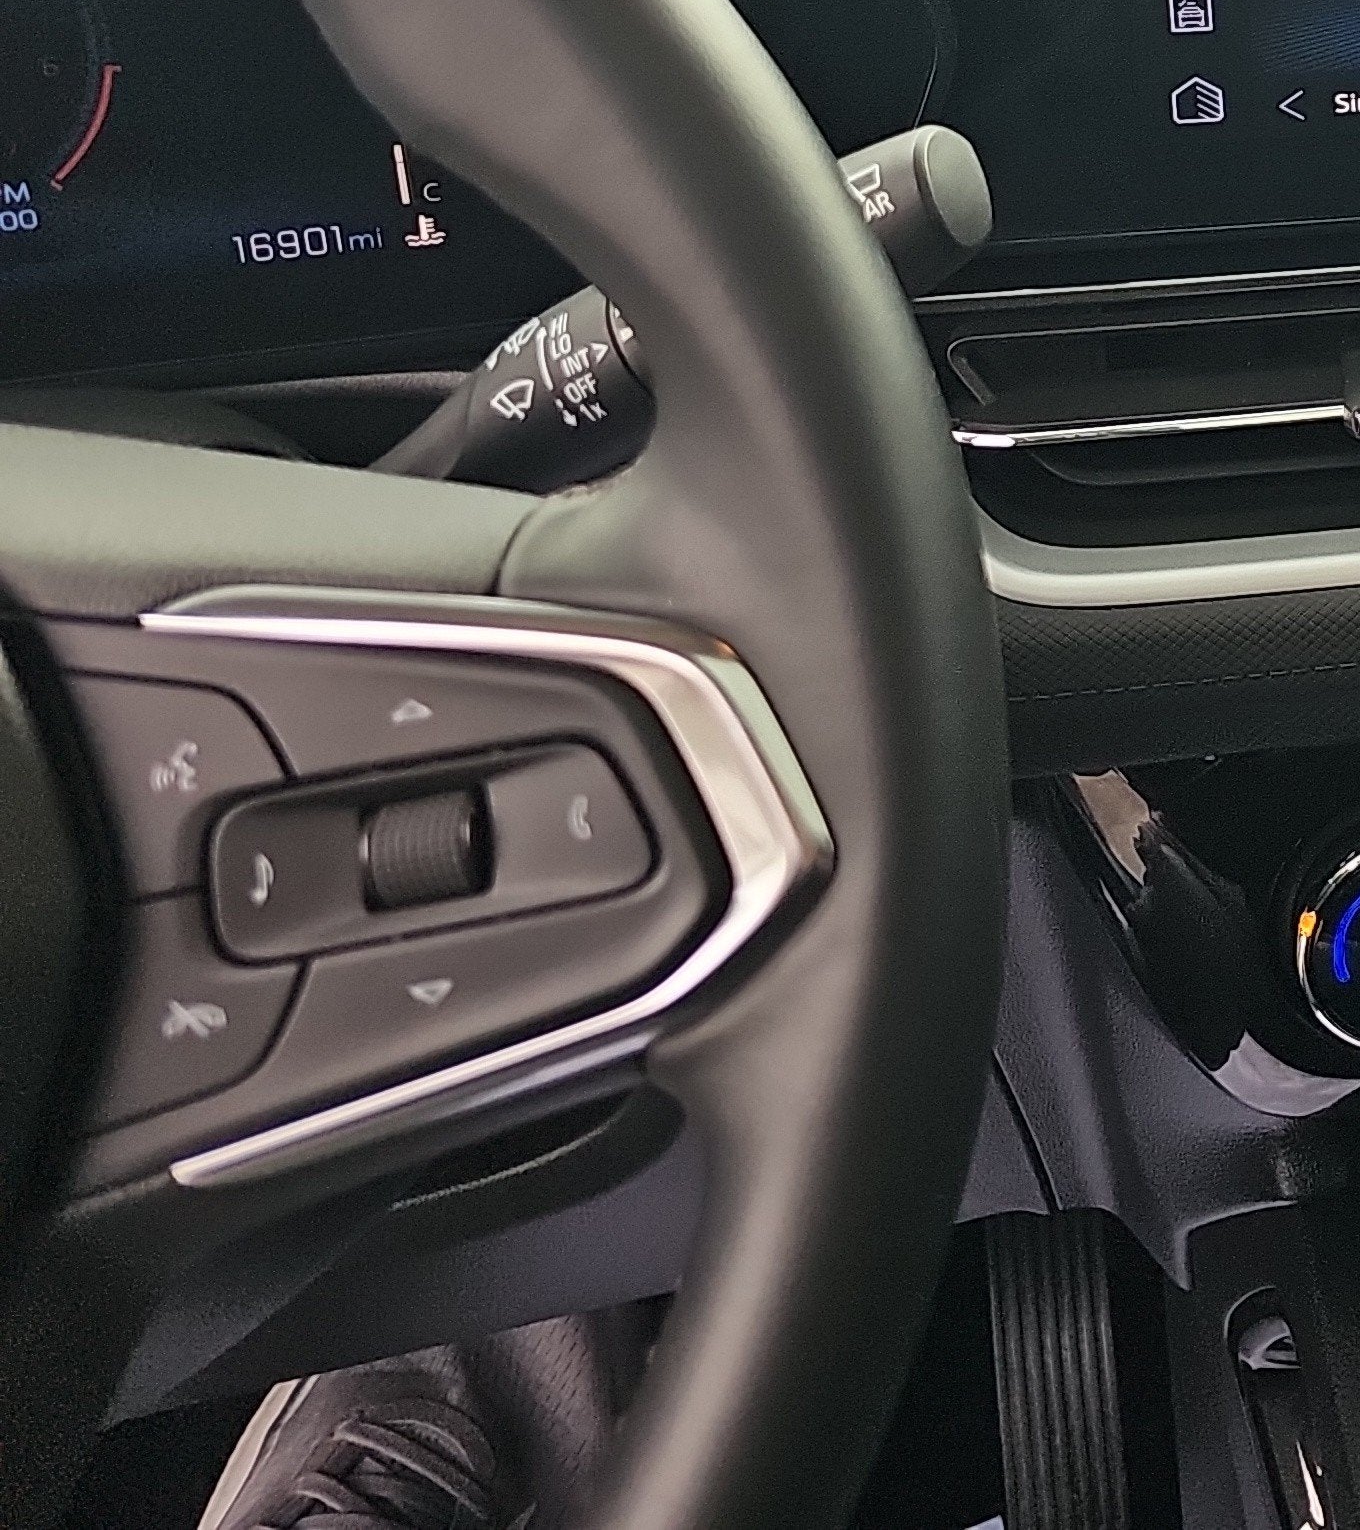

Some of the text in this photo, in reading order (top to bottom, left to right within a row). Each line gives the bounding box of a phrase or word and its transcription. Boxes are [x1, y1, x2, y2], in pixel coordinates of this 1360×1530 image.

[863, 190, 895, 223] AR
[231, 224, 383, 264] 16901 mi
[550, 312, 569, 339] HI
[551, 333, 572, 361] LO
[560, 347, 590, 378] INT
[563, 372, 597, 404] OFF
